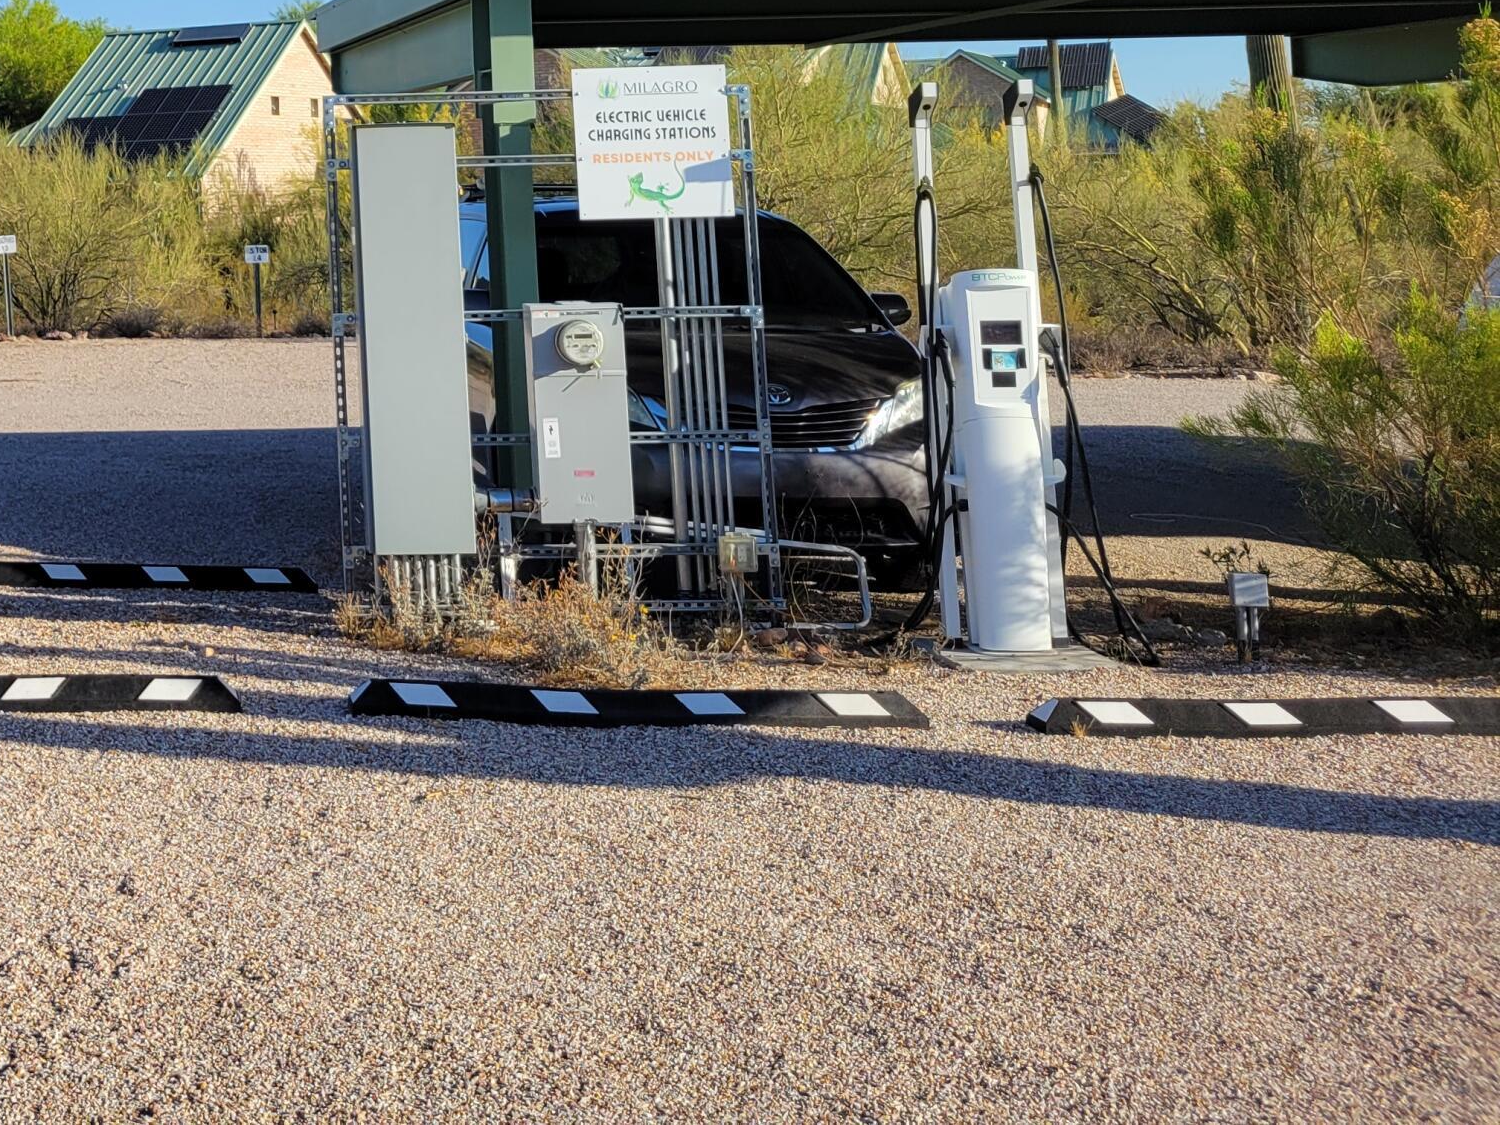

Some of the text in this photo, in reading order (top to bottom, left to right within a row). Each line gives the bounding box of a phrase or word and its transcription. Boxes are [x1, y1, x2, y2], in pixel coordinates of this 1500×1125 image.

[623, 80, 698, 94] MILAGRO
[595, 108, 706, 124] ELECTRIC VEHICLE
[588, 125, 717, 142] CHARGING STATIONS
[592, 150, 714, 164] RESIDENTS ONLY
